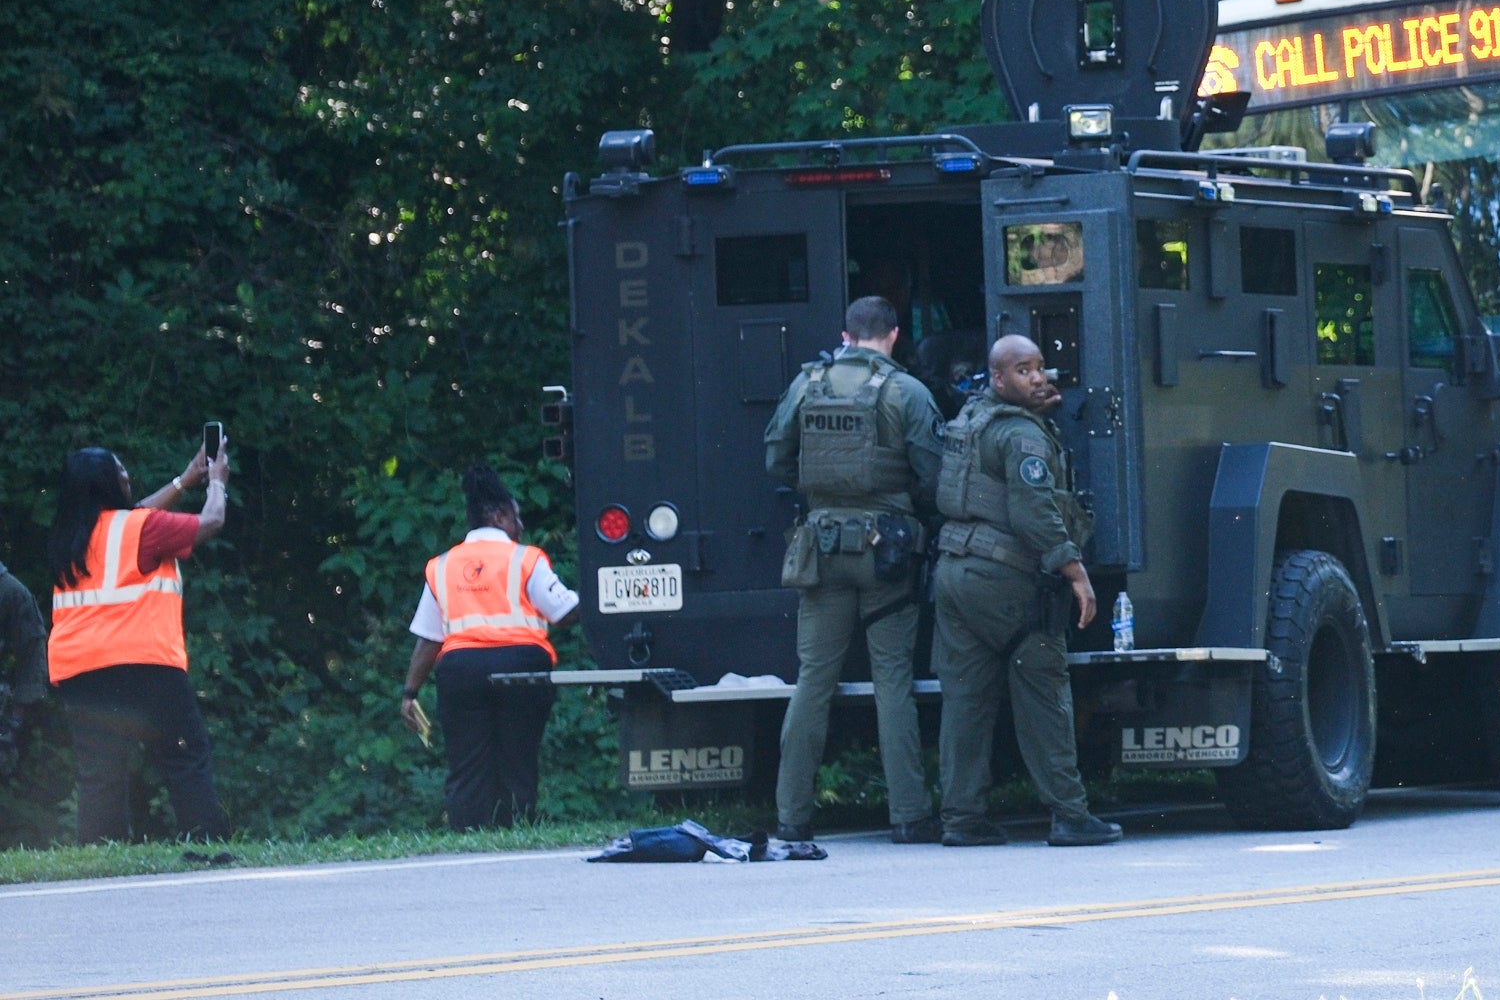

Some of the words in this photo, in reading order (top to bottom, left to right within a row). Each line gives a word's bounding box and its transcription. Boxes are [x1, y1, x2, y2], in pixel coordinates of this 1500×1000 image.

[1254, 33, 1339, 90] CALL
[1343, 13, 1465, 78] POLICE
[615, 241, 655, 461] DEKALB
[804, 414, 866, 432] POLICE
[1122, 725, 1240, 750] LENCO
[629, 746, 744, 772] LENCO
[1122, 749, 1175, 763] ARMORED
[1186, 747, 1239, 760] VEHICLES
[629, 772, 681, 786] ARMORED
[692, 768, 743, 782] VEHICLES
